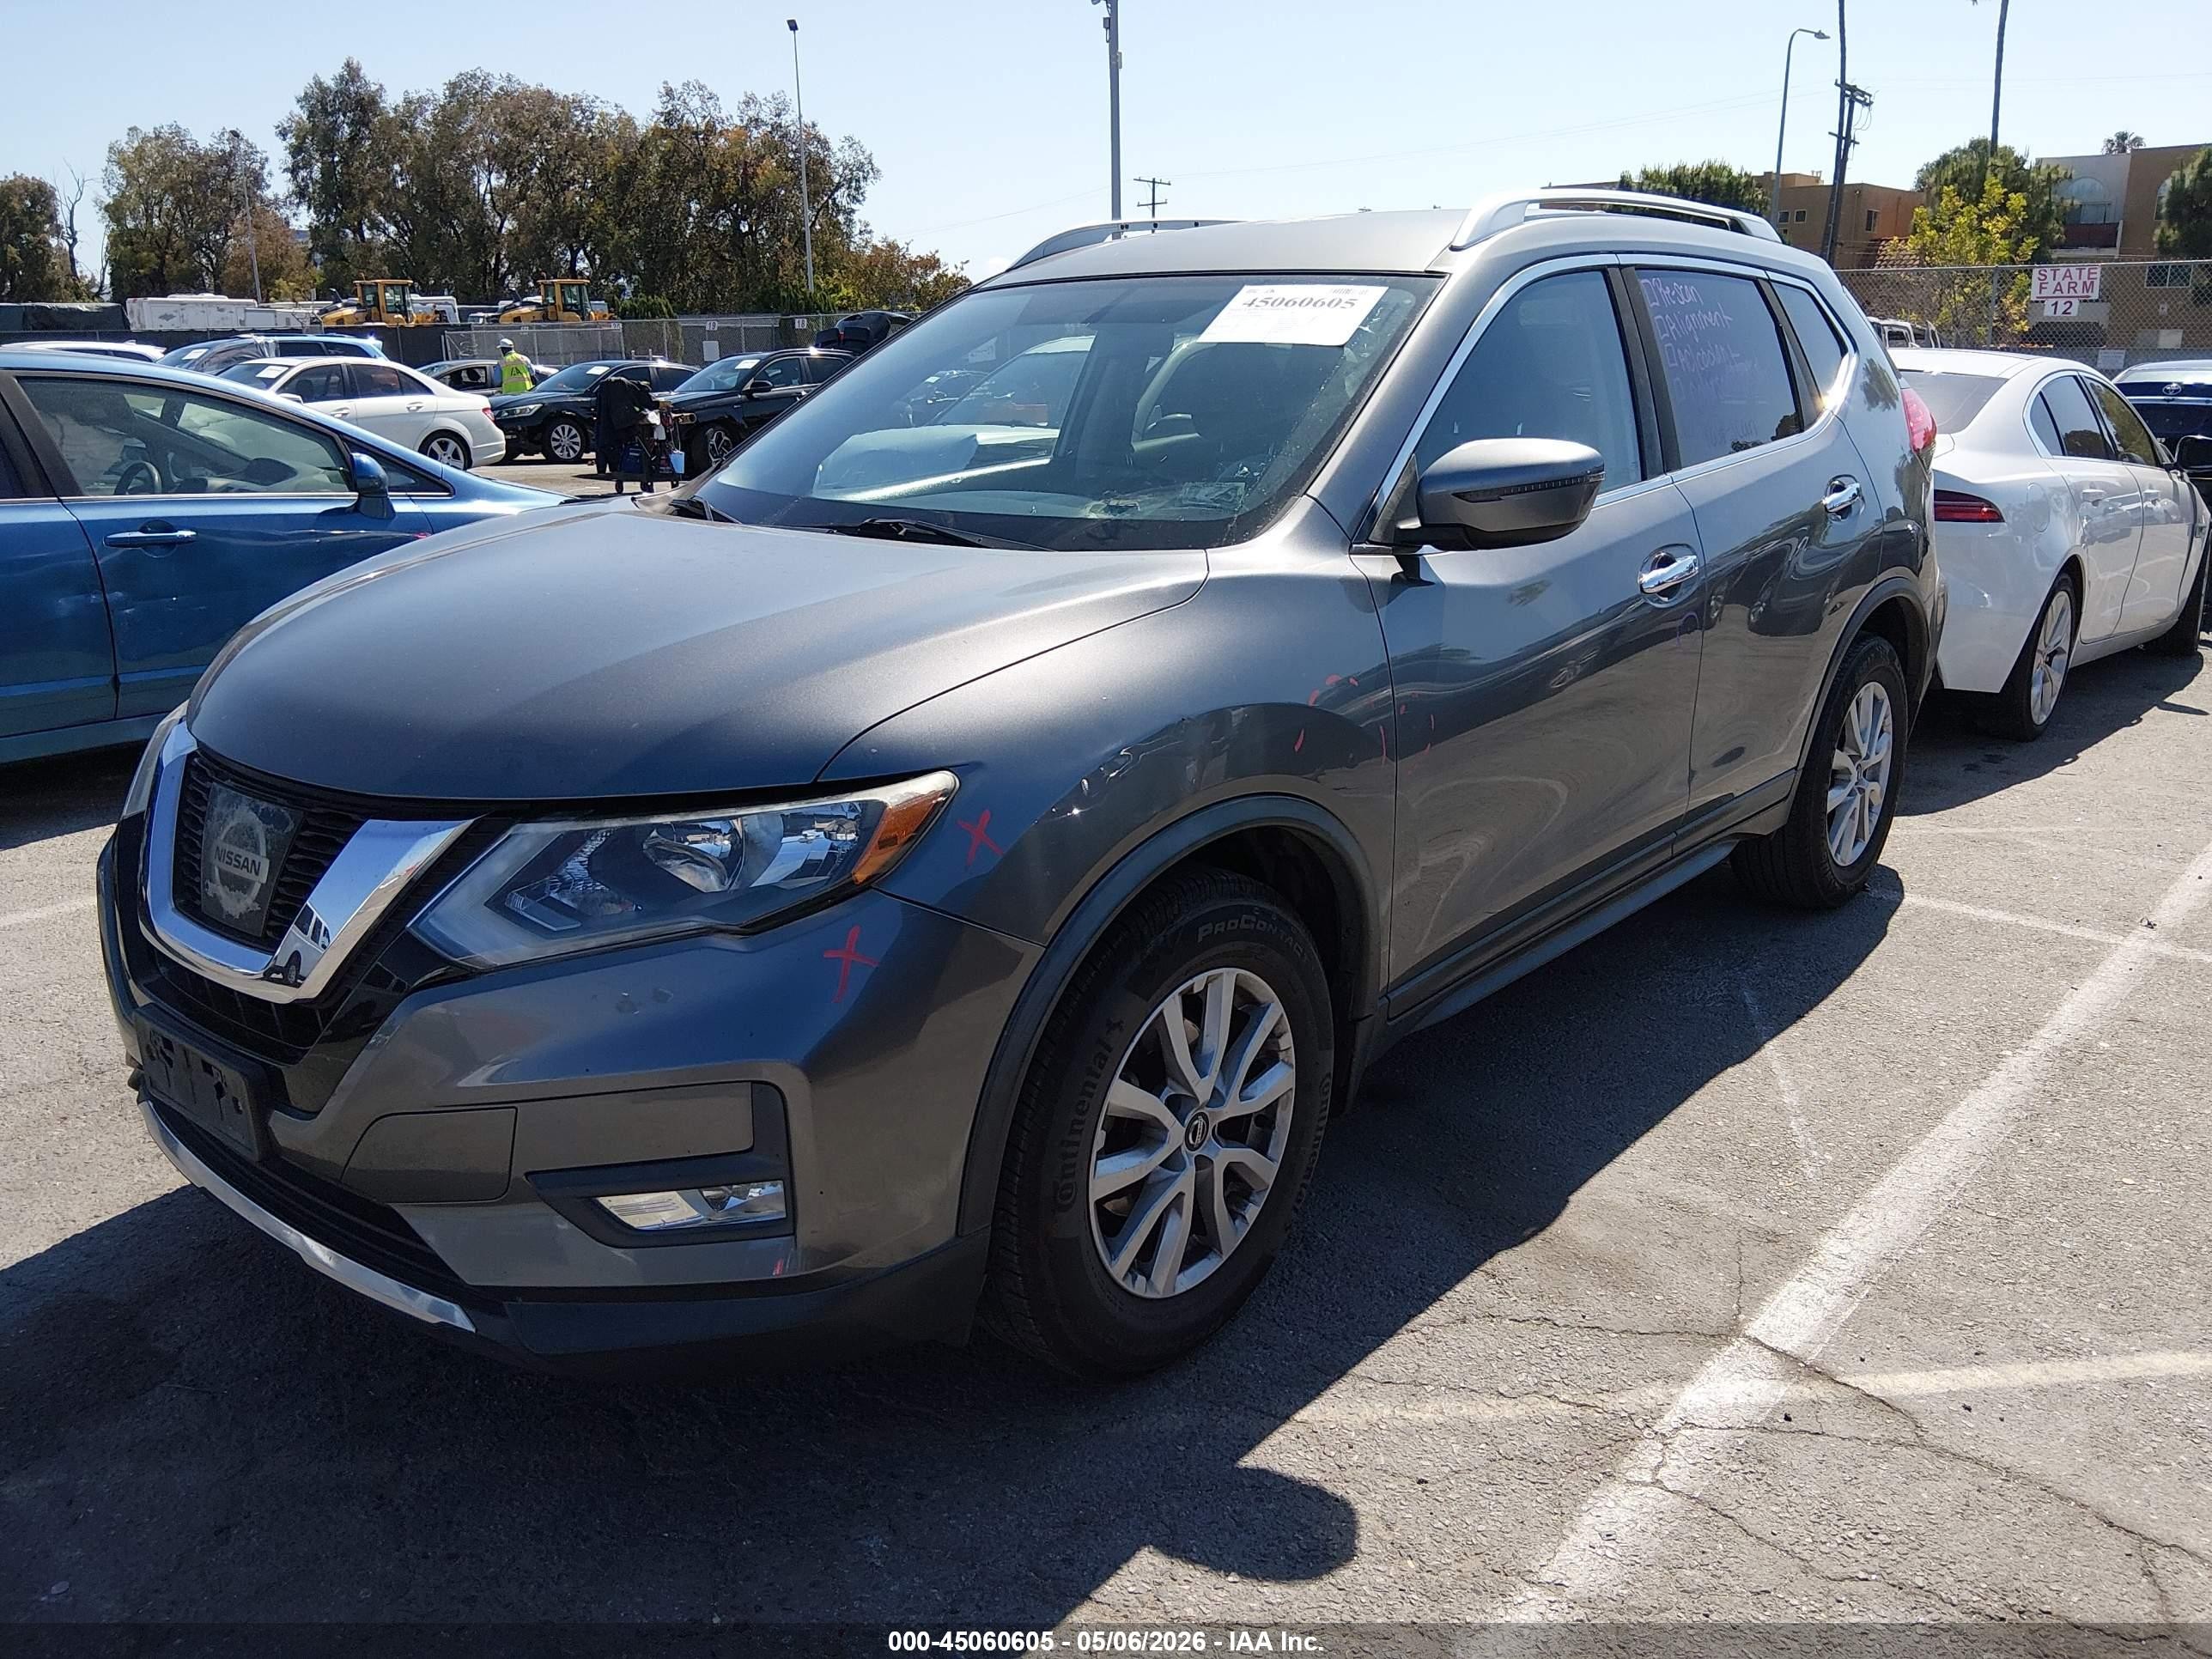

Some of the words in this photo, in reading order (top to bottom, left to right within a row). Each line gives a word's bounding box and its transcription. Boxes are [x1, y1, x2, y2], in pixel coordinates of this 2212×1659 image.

[2037, 267, 2098, 282] STATE
[2039, 280, 2094, 295] FARM
[1243, 296, 1359, 310] 45060605
[2051, 300, 2073, 315] 12
[708, 321, 716, 330] 19
[797, 319, 805, 328] 18
[1664, 302, 1733, 343] Alignment
[214, 846, 262, 877] NISSAN
[1053, 1037, 1114, 1213] Continental
